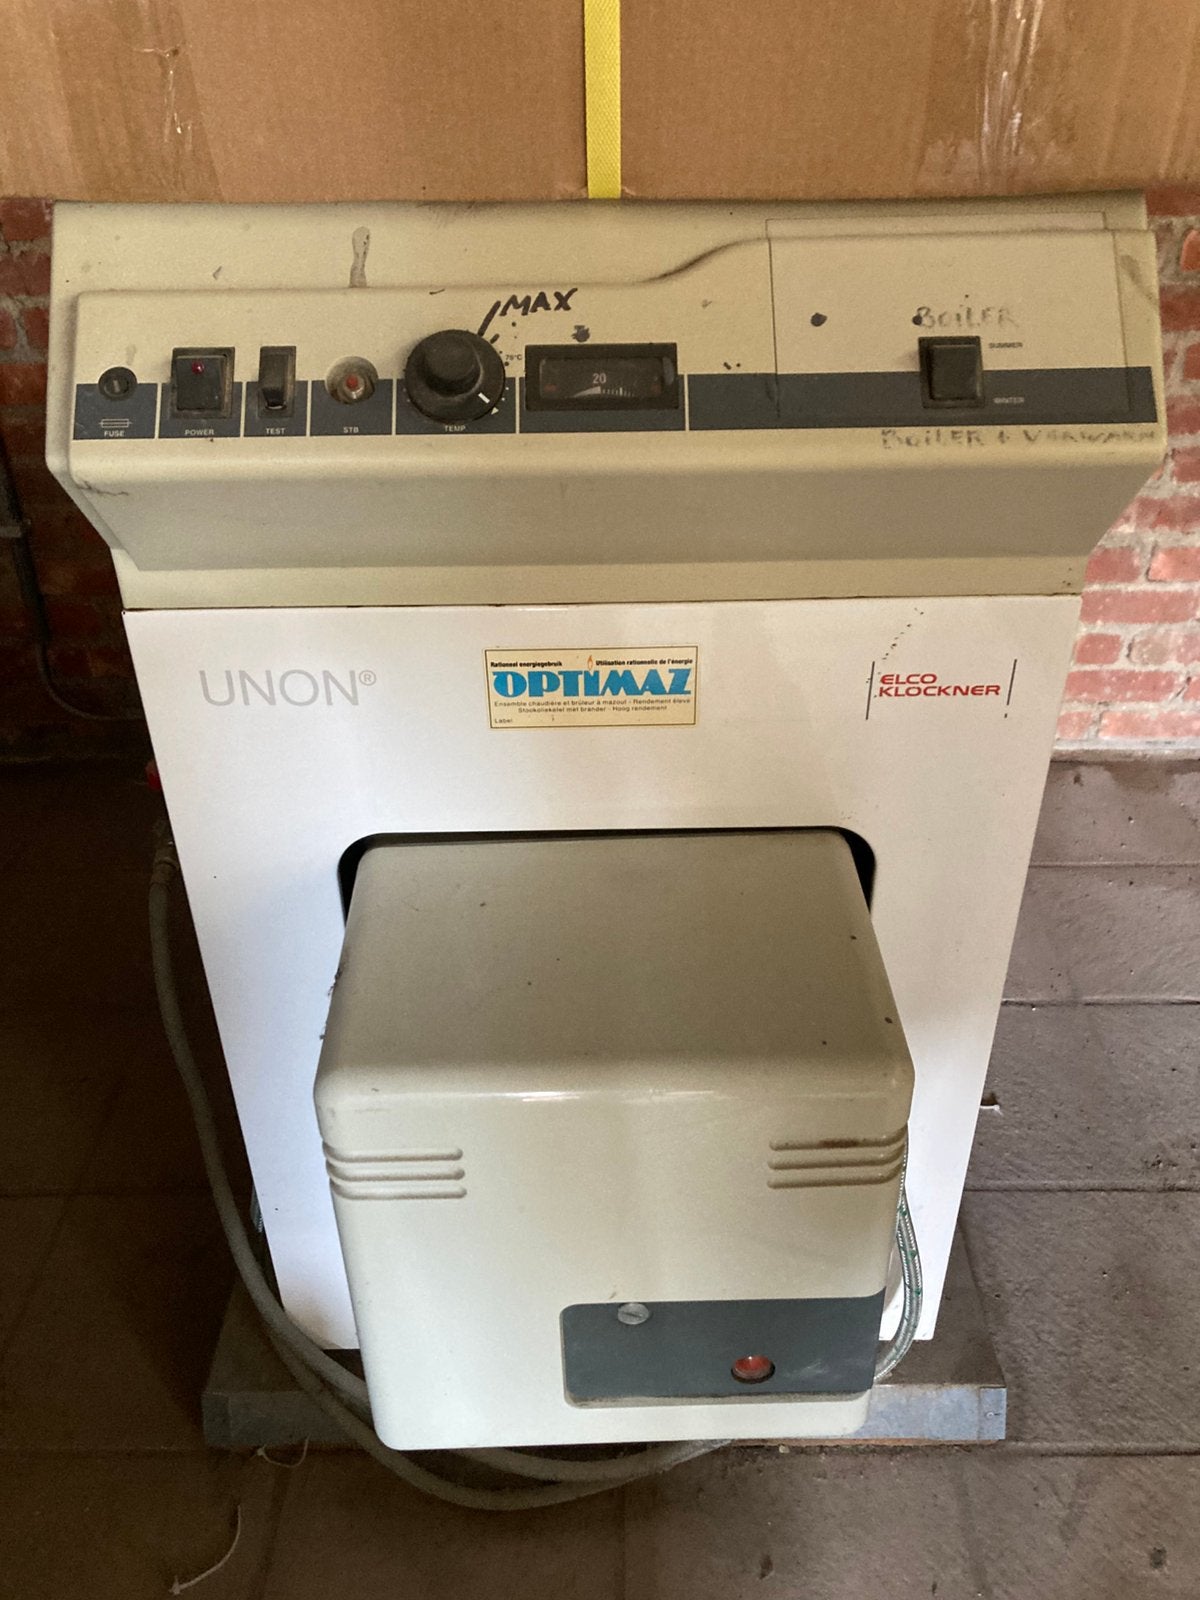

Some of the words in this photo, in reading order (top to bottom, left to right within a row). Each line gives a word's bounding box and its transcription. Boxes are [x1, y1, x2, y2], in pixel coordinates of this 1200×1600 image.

[500, 287, 578, 316] MAX
[592, 373, 607, 384] 20
[185, 428, 215, 436] POWER
[343, 426, 359, 434] STB
[492, 668, 692, 698] OPTIMAZ
[880, 673, 938, 685] ELCO
